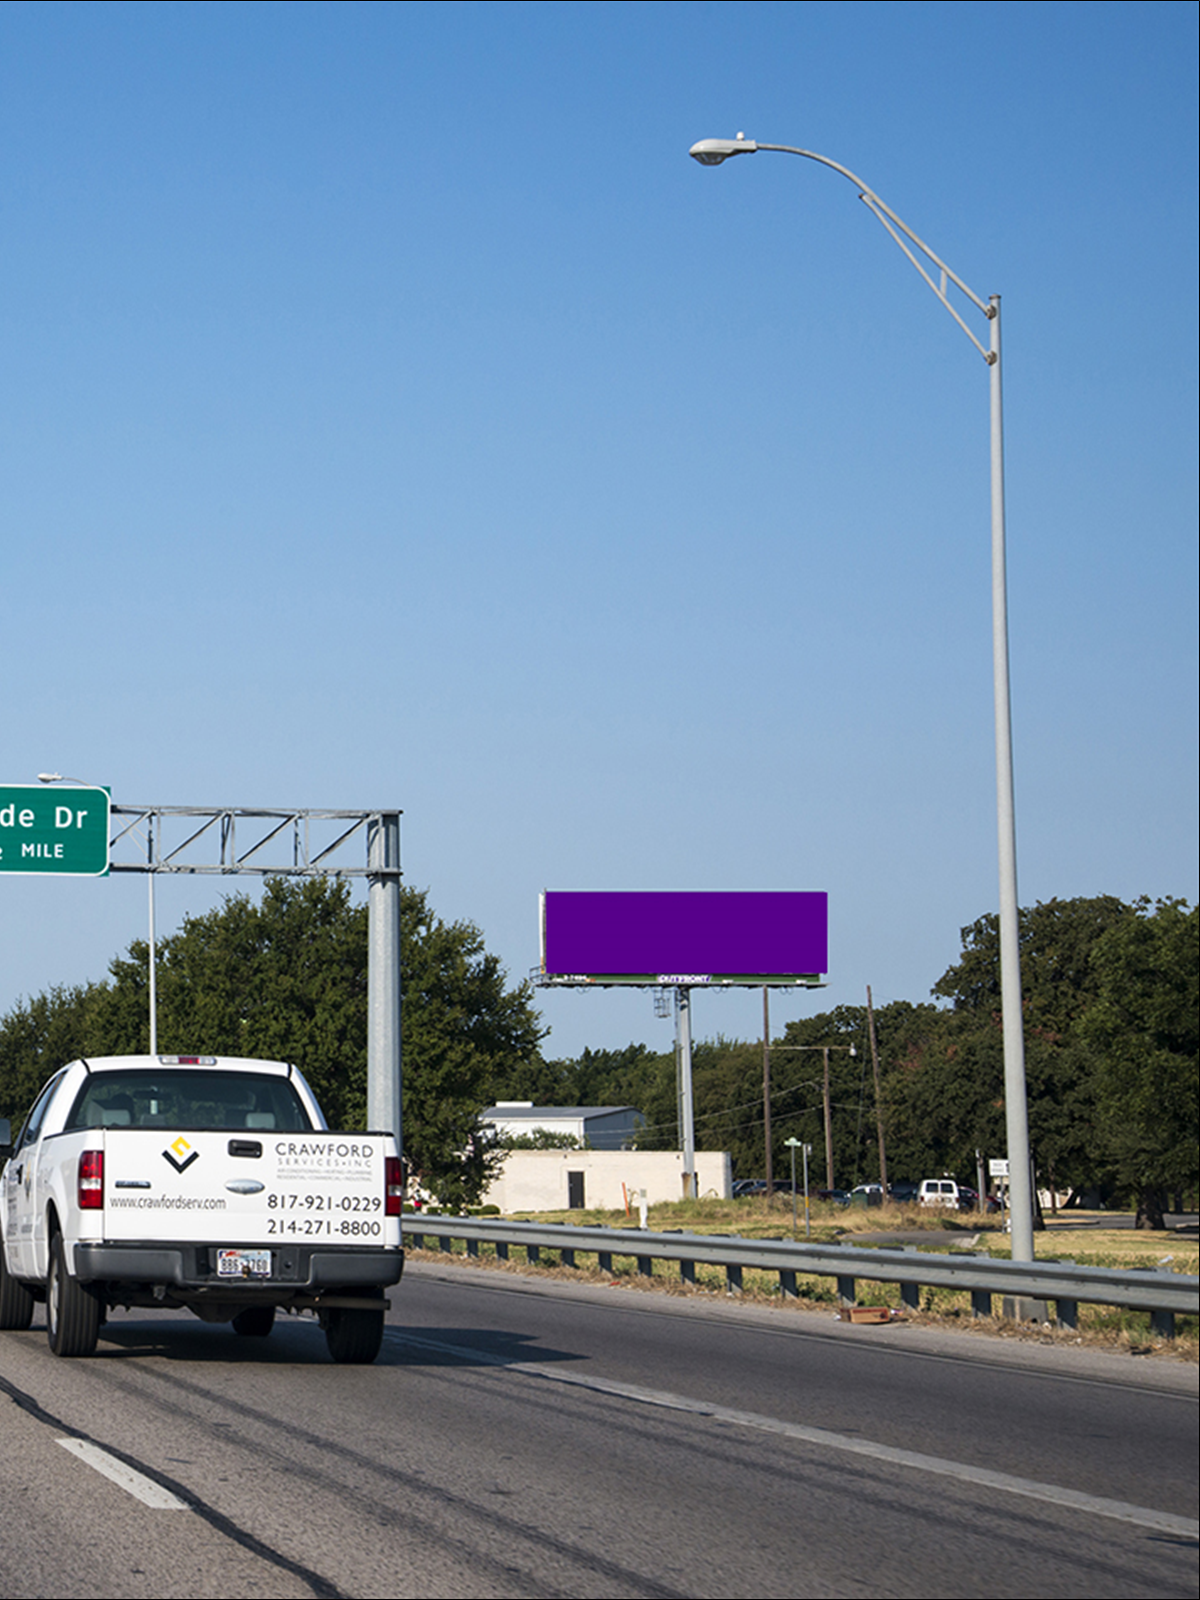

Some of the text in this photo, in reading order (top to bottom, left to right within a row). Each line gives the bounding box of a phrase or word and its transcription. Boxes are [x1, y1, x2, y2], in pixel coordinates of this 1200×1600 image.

[54, 806, 88, 829] Dr
[21, 843, 64, 858] MILE
[275, 1142, 374, 1158] CRAWFORD
[109, 1193, 227, 1210] www.crawfordserv.com
[267, 1194, 382, 1212] 817-921-0229
[267, 1218, 381, 1237] 214-271-8800
